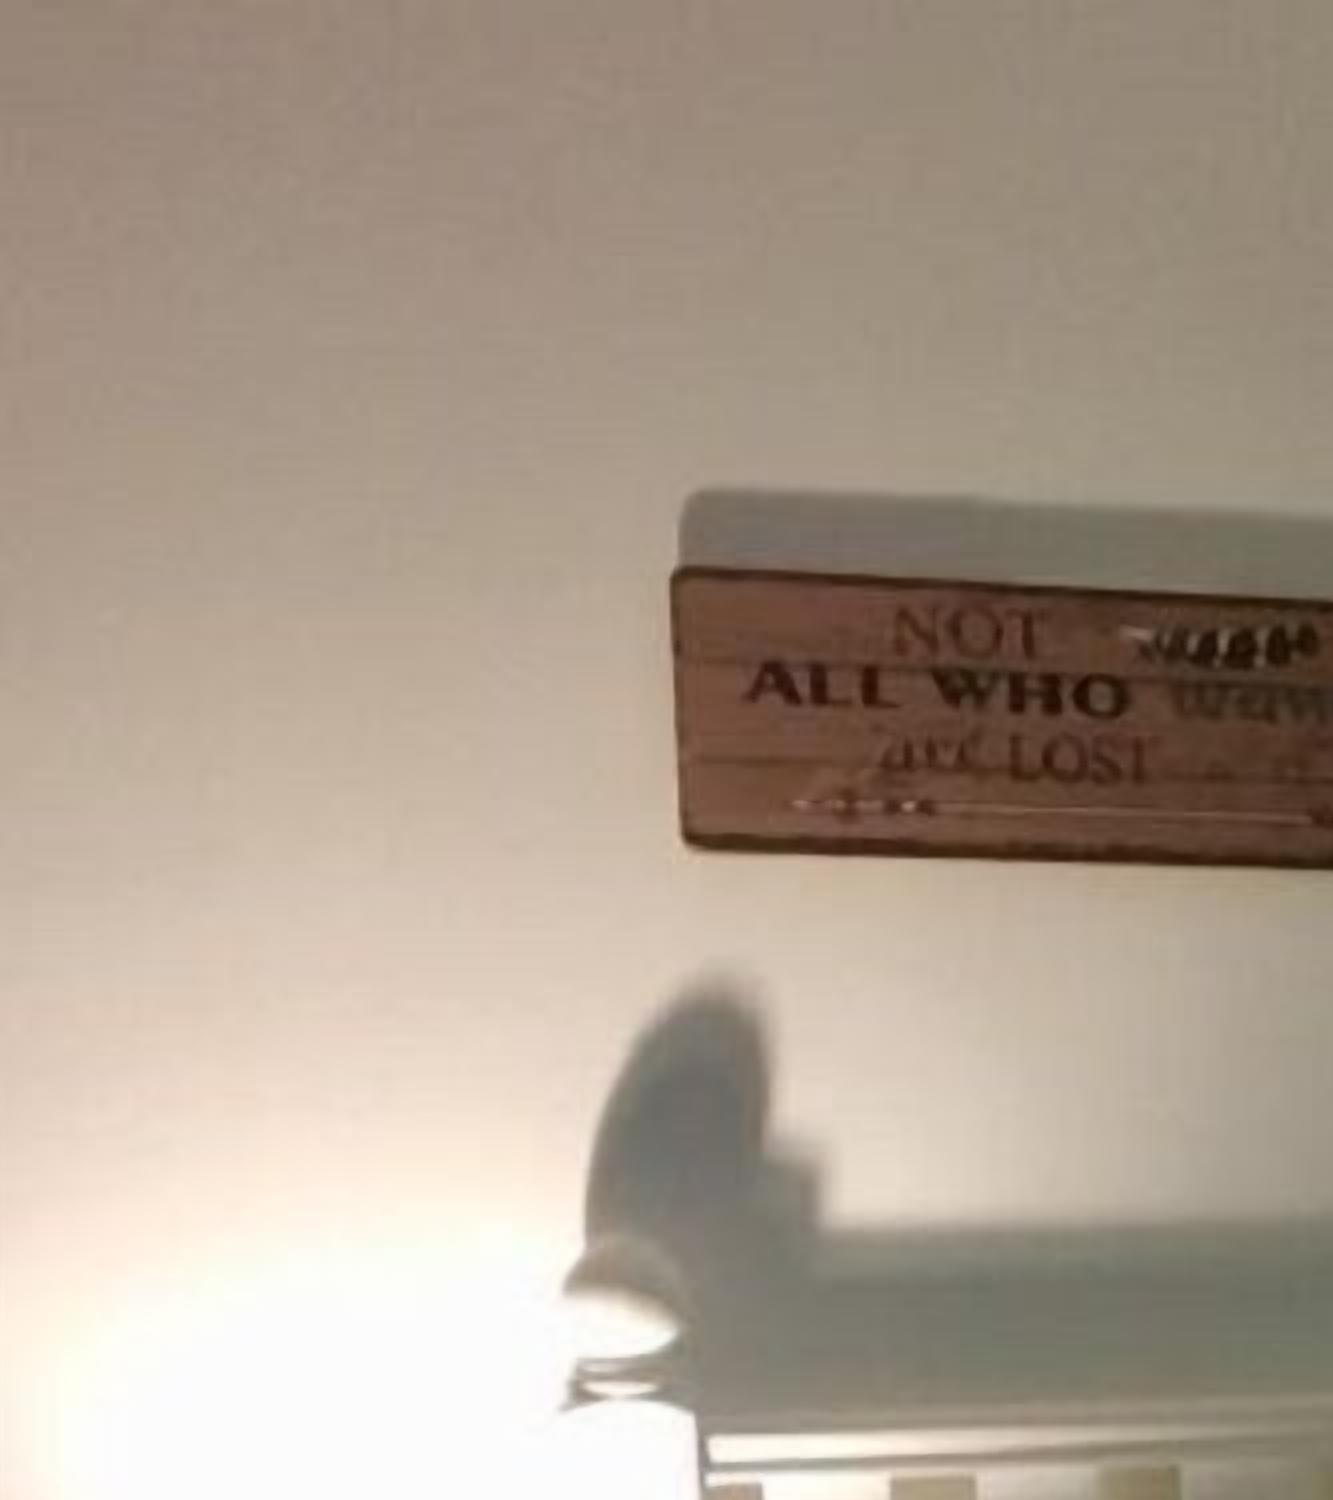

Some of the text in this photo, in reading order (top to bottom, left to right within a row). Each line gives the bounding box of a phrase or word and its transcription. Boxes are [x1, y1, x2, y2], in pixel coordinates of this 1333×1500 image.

[892, 604, 1047, 661] NOT
[741, 659, 902, 709] ALL
[929, 665, 1133, 721] WHO
[1007, 734, 1157, 785] LOST
